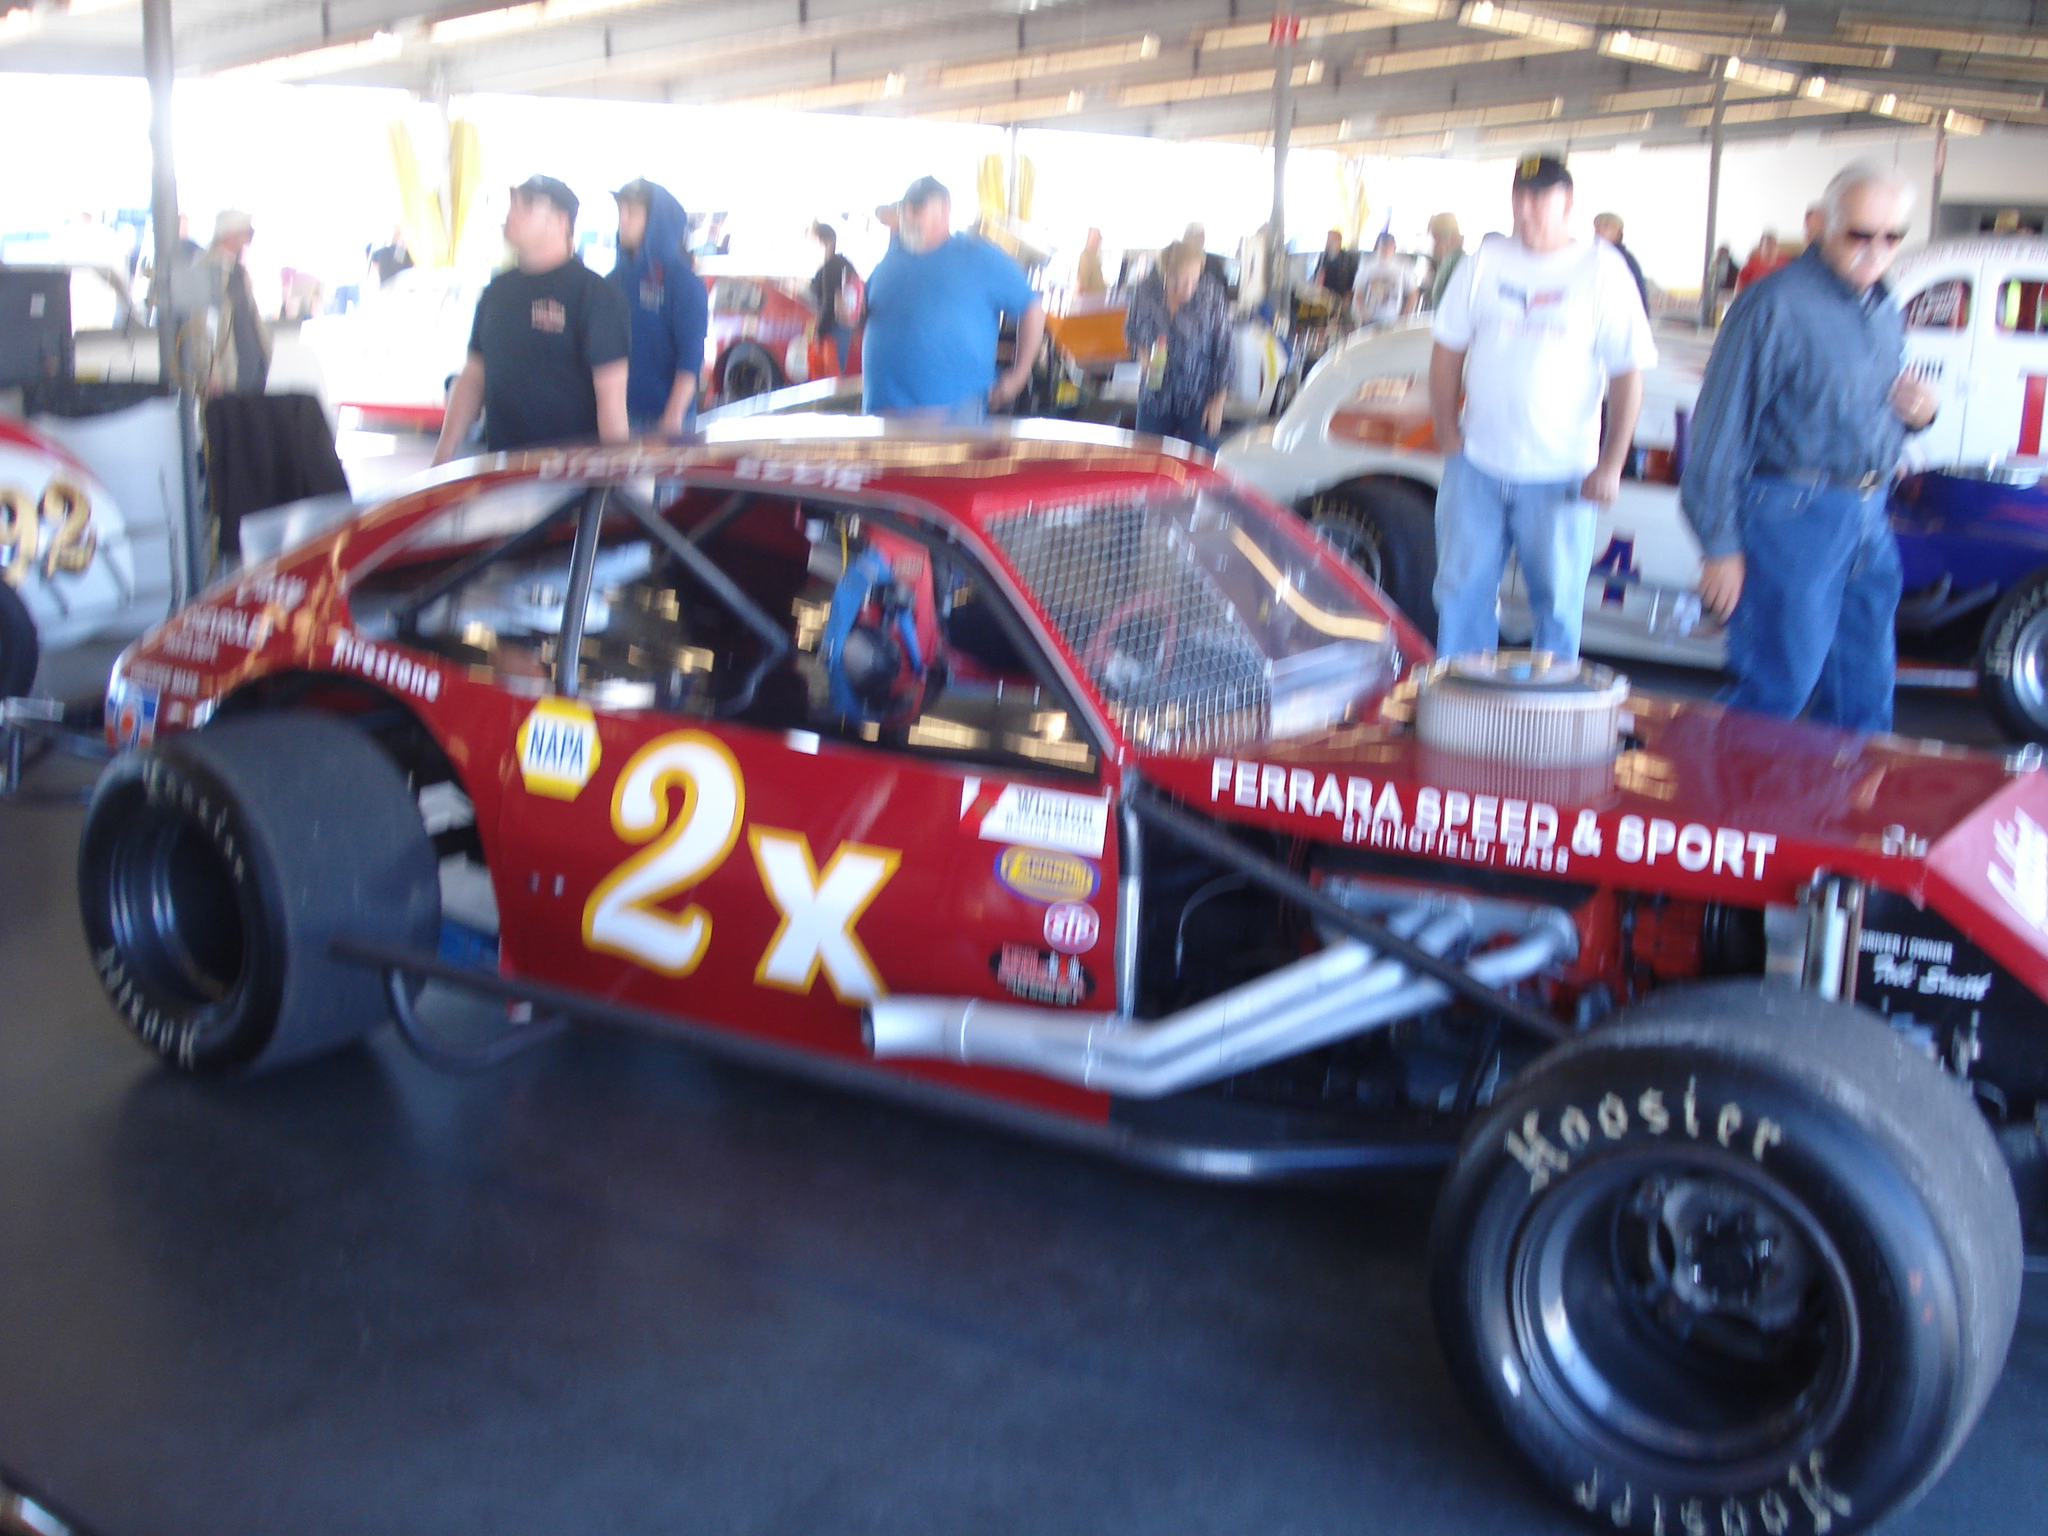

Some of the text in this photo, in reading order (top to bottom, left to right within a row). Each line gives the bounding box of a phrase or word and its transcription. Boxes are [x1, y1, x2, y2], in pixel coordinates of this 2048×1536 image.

[527, 718, 585, 775] NAPA
[1210, 757, 1778, 881] FERRARA SPEED & SPORT
